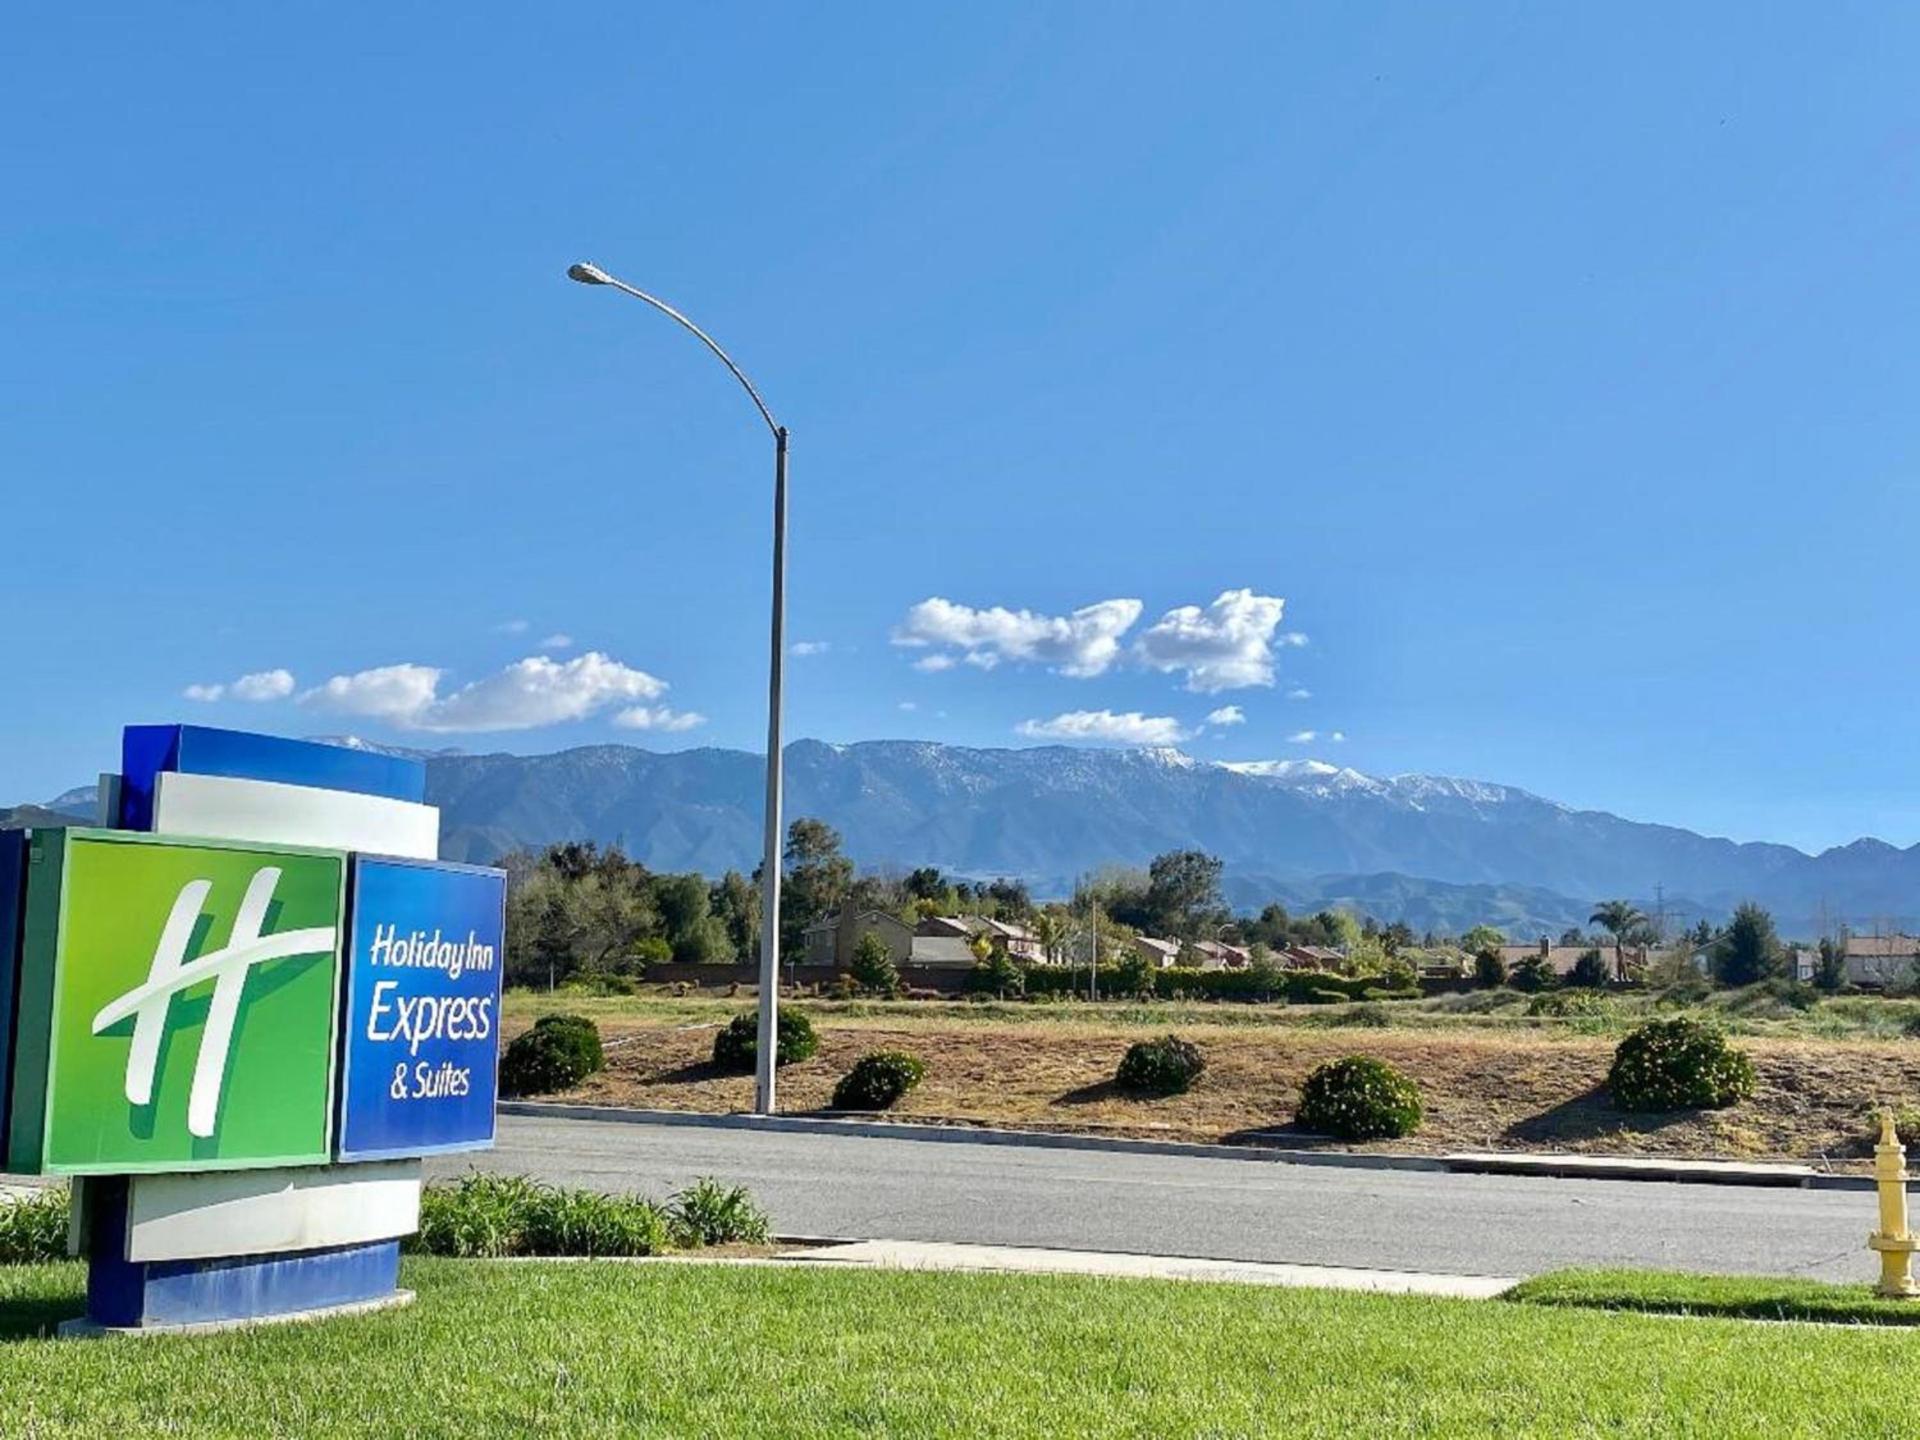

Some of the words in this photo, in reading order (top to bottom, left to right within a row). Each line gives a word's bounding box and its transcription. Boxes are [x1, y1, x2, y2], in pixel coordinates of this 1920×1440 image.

[370, 923, 464, 980] Holiday
[465, 930, 493, 971] Inn
[92, 866, 336, 1138] H
[367, 980, 491, 1057] Express
[390, 1062, 408, 1099] &
[412, 1061, 470, 1098] Suites
